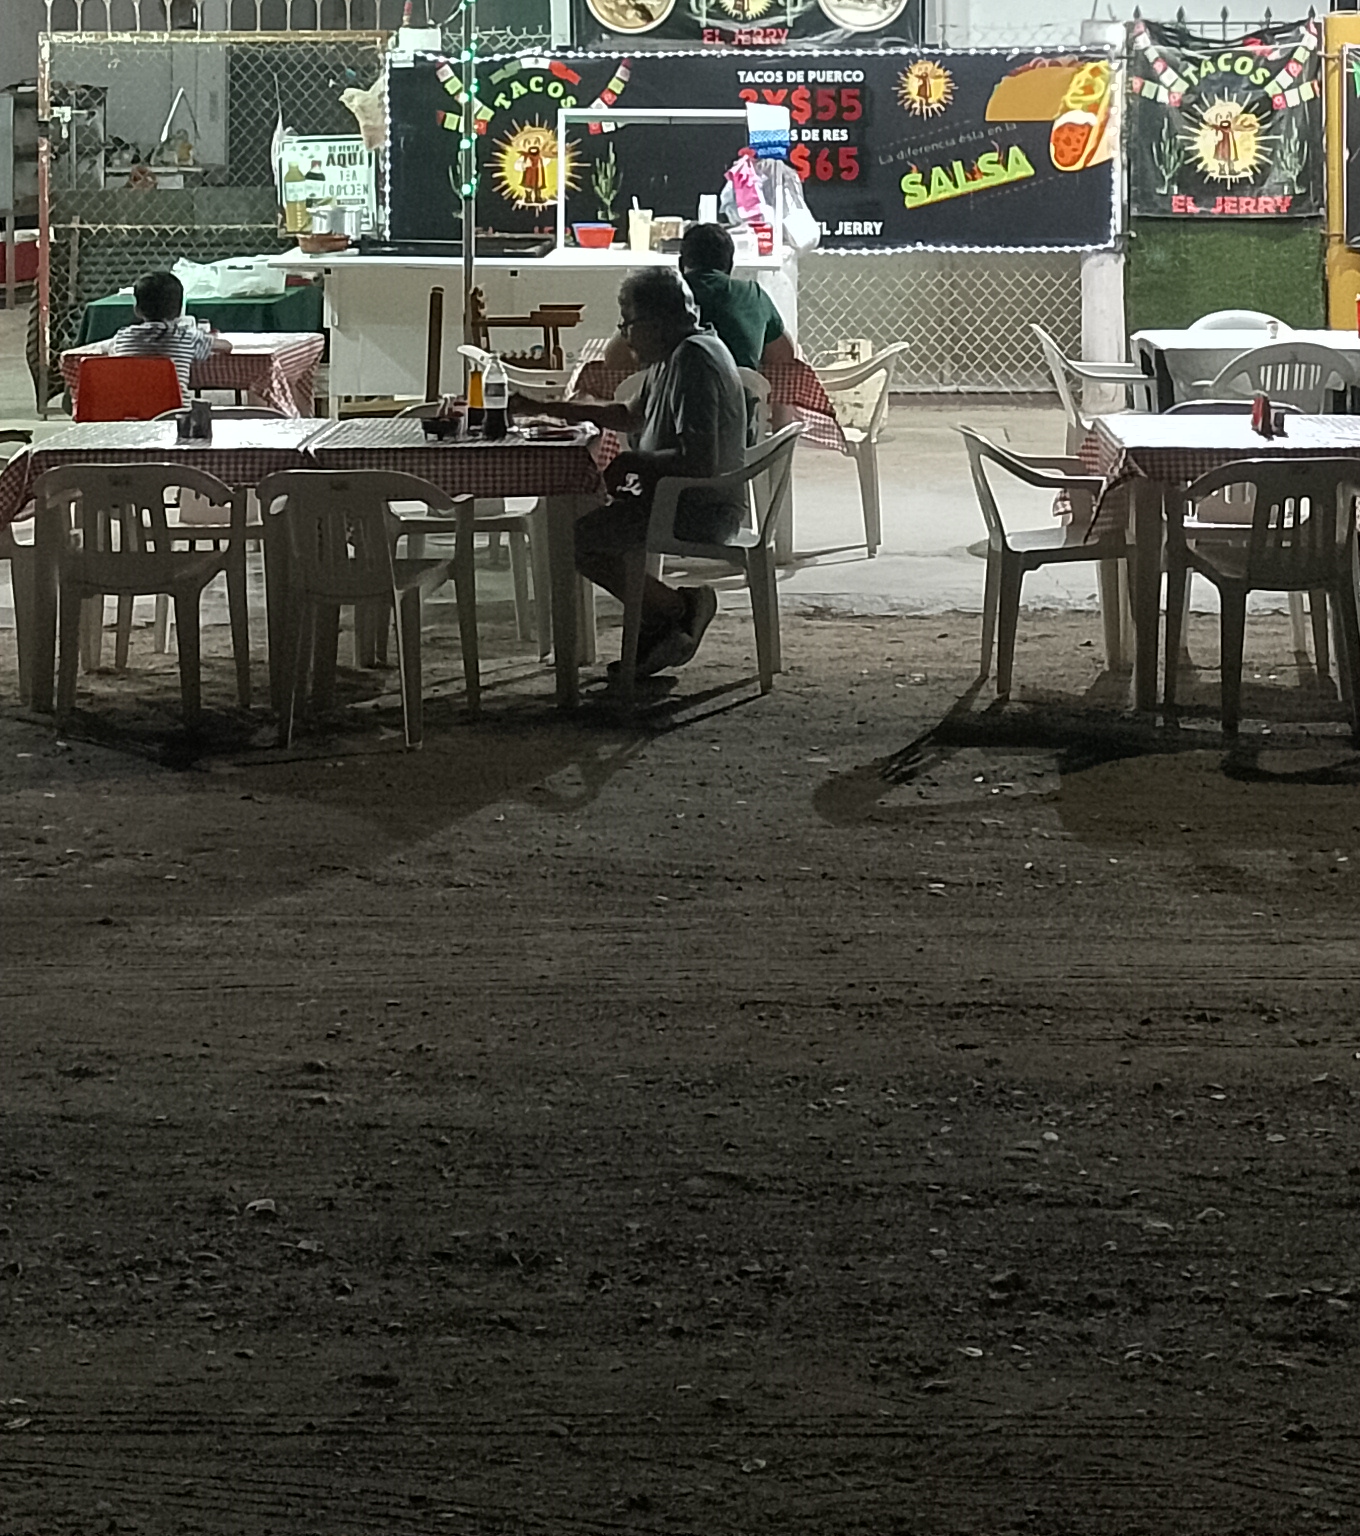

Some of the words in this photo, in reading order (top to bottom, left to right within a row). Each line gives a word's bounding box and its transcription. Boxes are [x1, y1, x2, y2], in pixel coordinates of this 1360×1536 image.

[703, 29, 725, 45] EL
[732, 28, 789, 45] JERRY
[737, 70, 784, 83] TACOS
[787, 70, 805, 83] DE
[808, 70, 865, 83] PUERCO
[1182, 52, 1271, 86] TACOS
[494, 76, 577, 110] TACOS
[801, 128, 819, 142] DE
[822, 128, 849, 142] RES
[901, 145, 1036, 210] SALSA
[1171, 195, 1201, 213] EL
[1210, 195, 1294, 214] JERRY
[834, 221, 884, 236] JERRY
